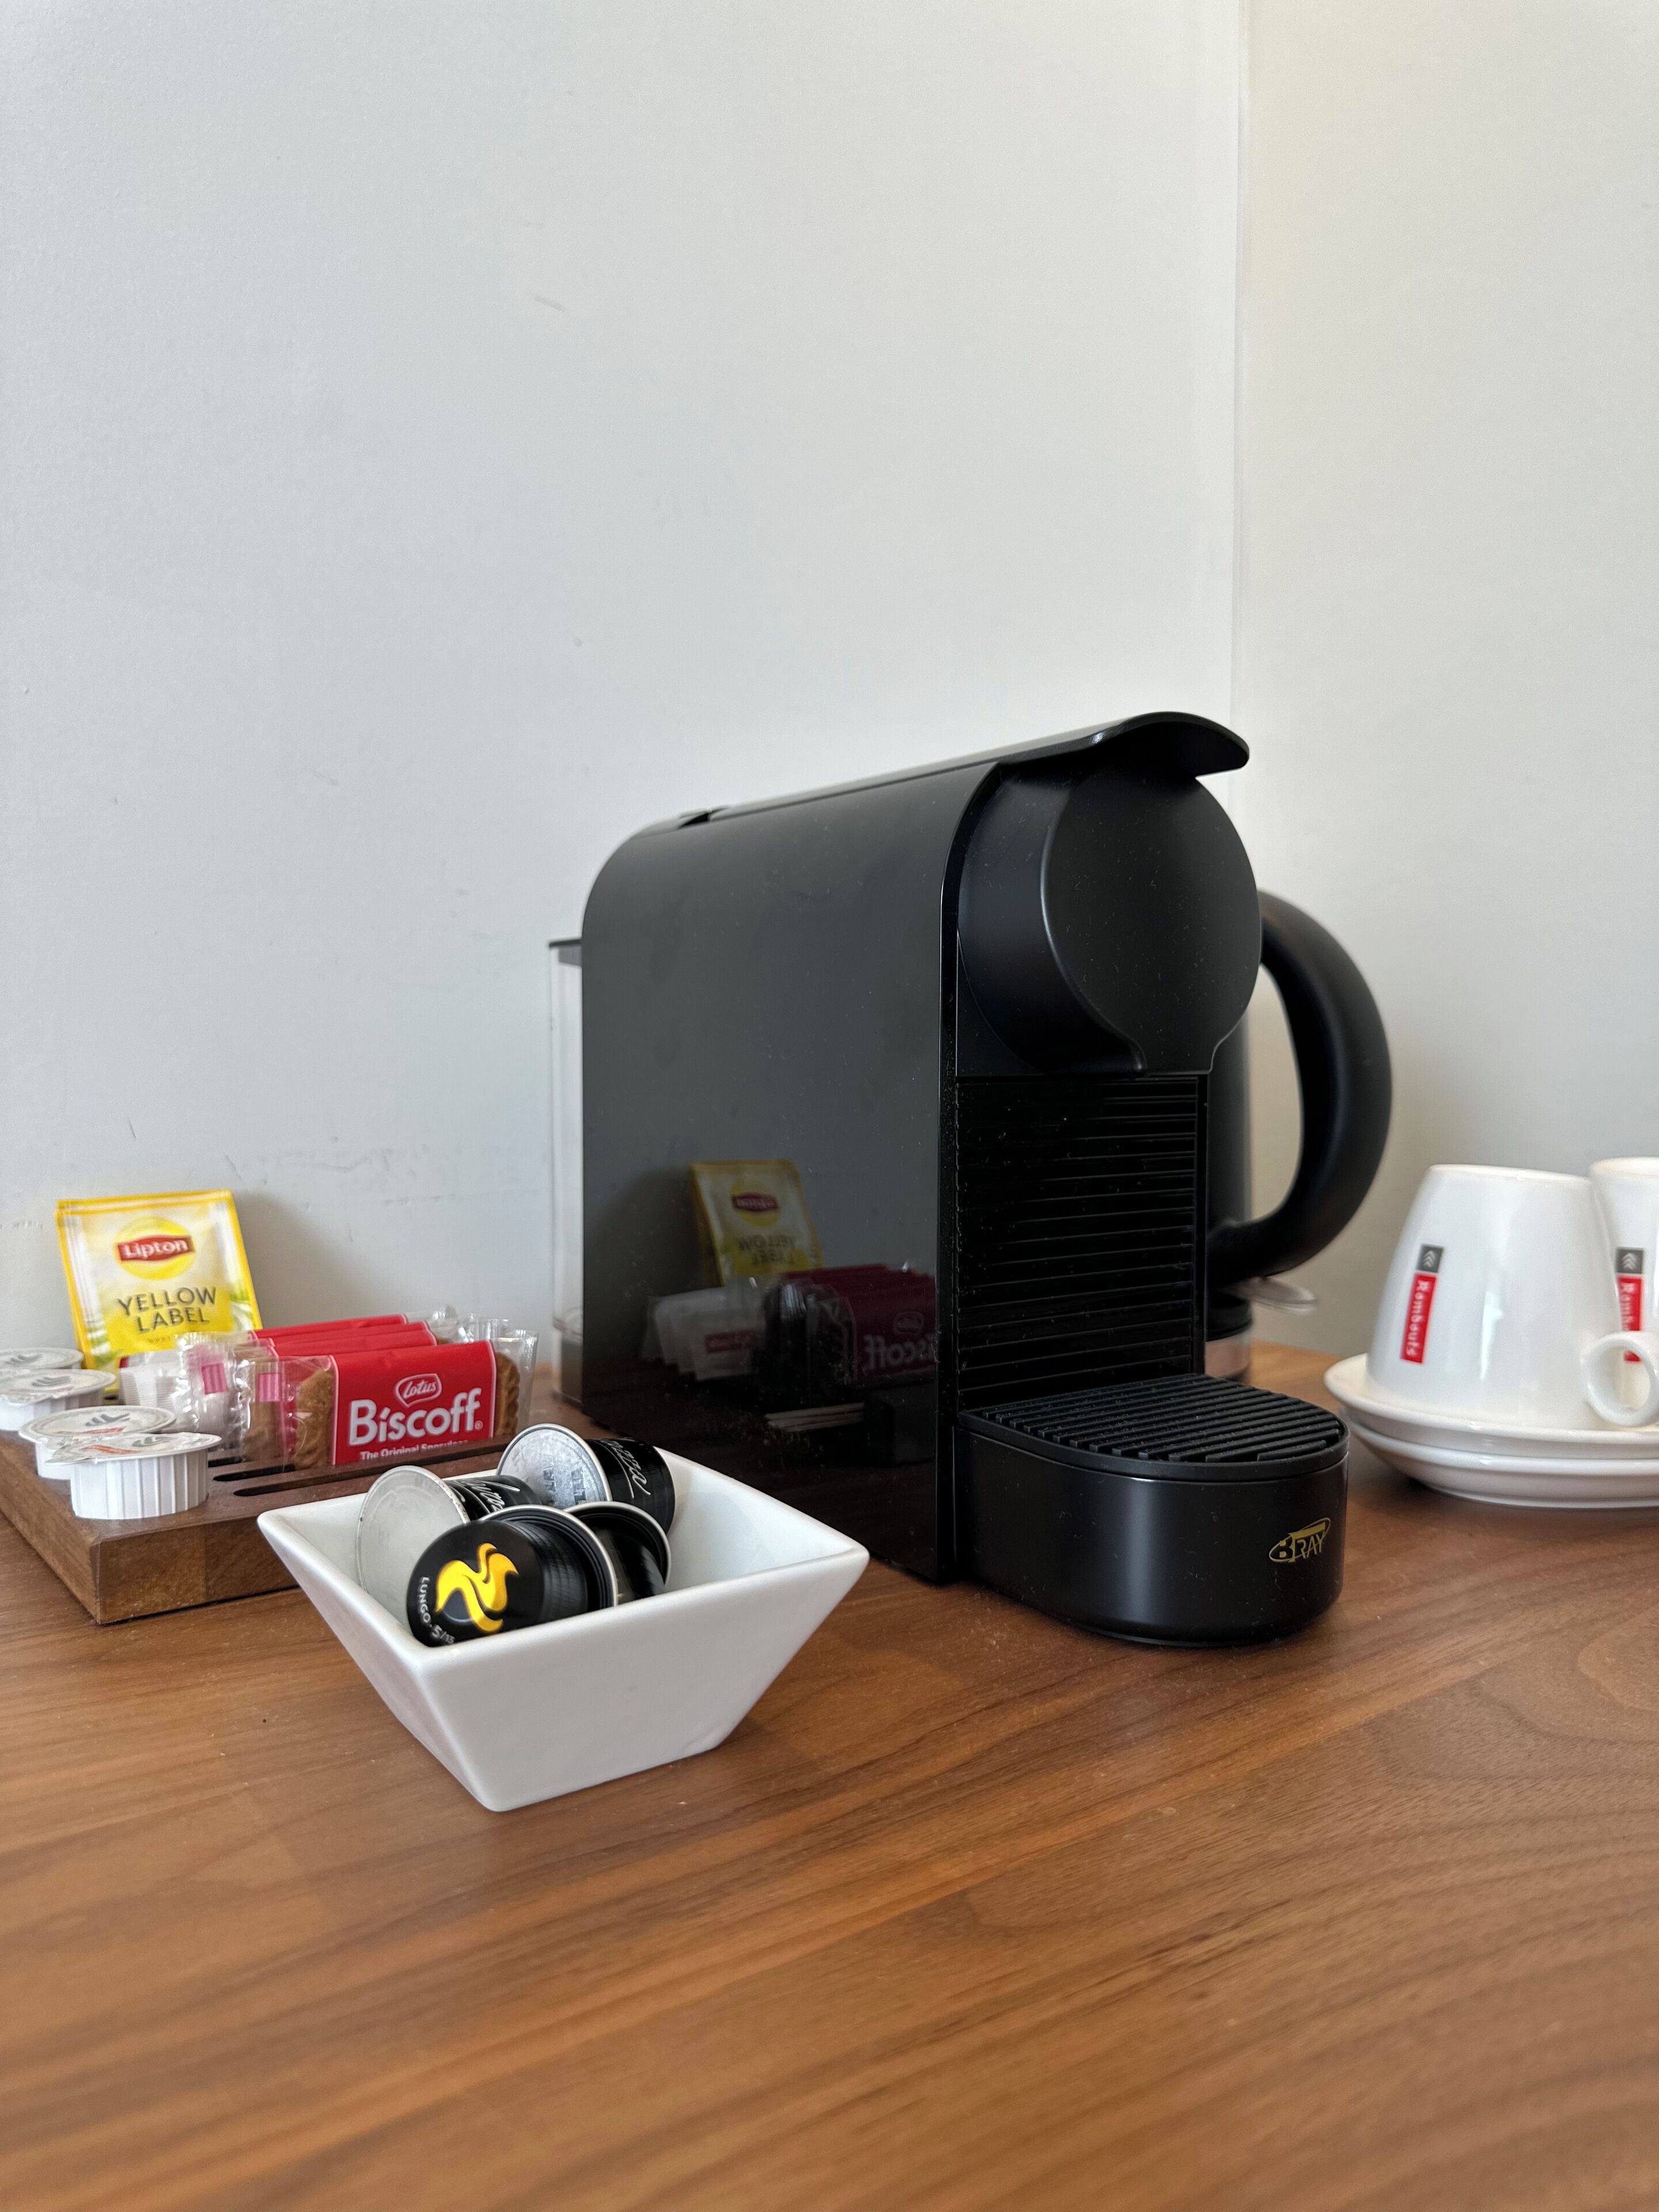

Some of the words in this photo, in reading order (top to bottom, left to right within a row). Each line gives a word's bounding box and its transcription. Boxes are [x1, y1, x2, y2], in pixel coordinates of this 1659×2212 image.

[123, 1239, 188, 1260] Lipton
[118, 1286, 217, 1316] YELLOW
[137, 1306, 210, 1333] LABEL
[403, 1379, 437, 1399] Lotus
[360, 1450, 379, 1460] The
[419, 1576, 430, 1623] LUNGO
